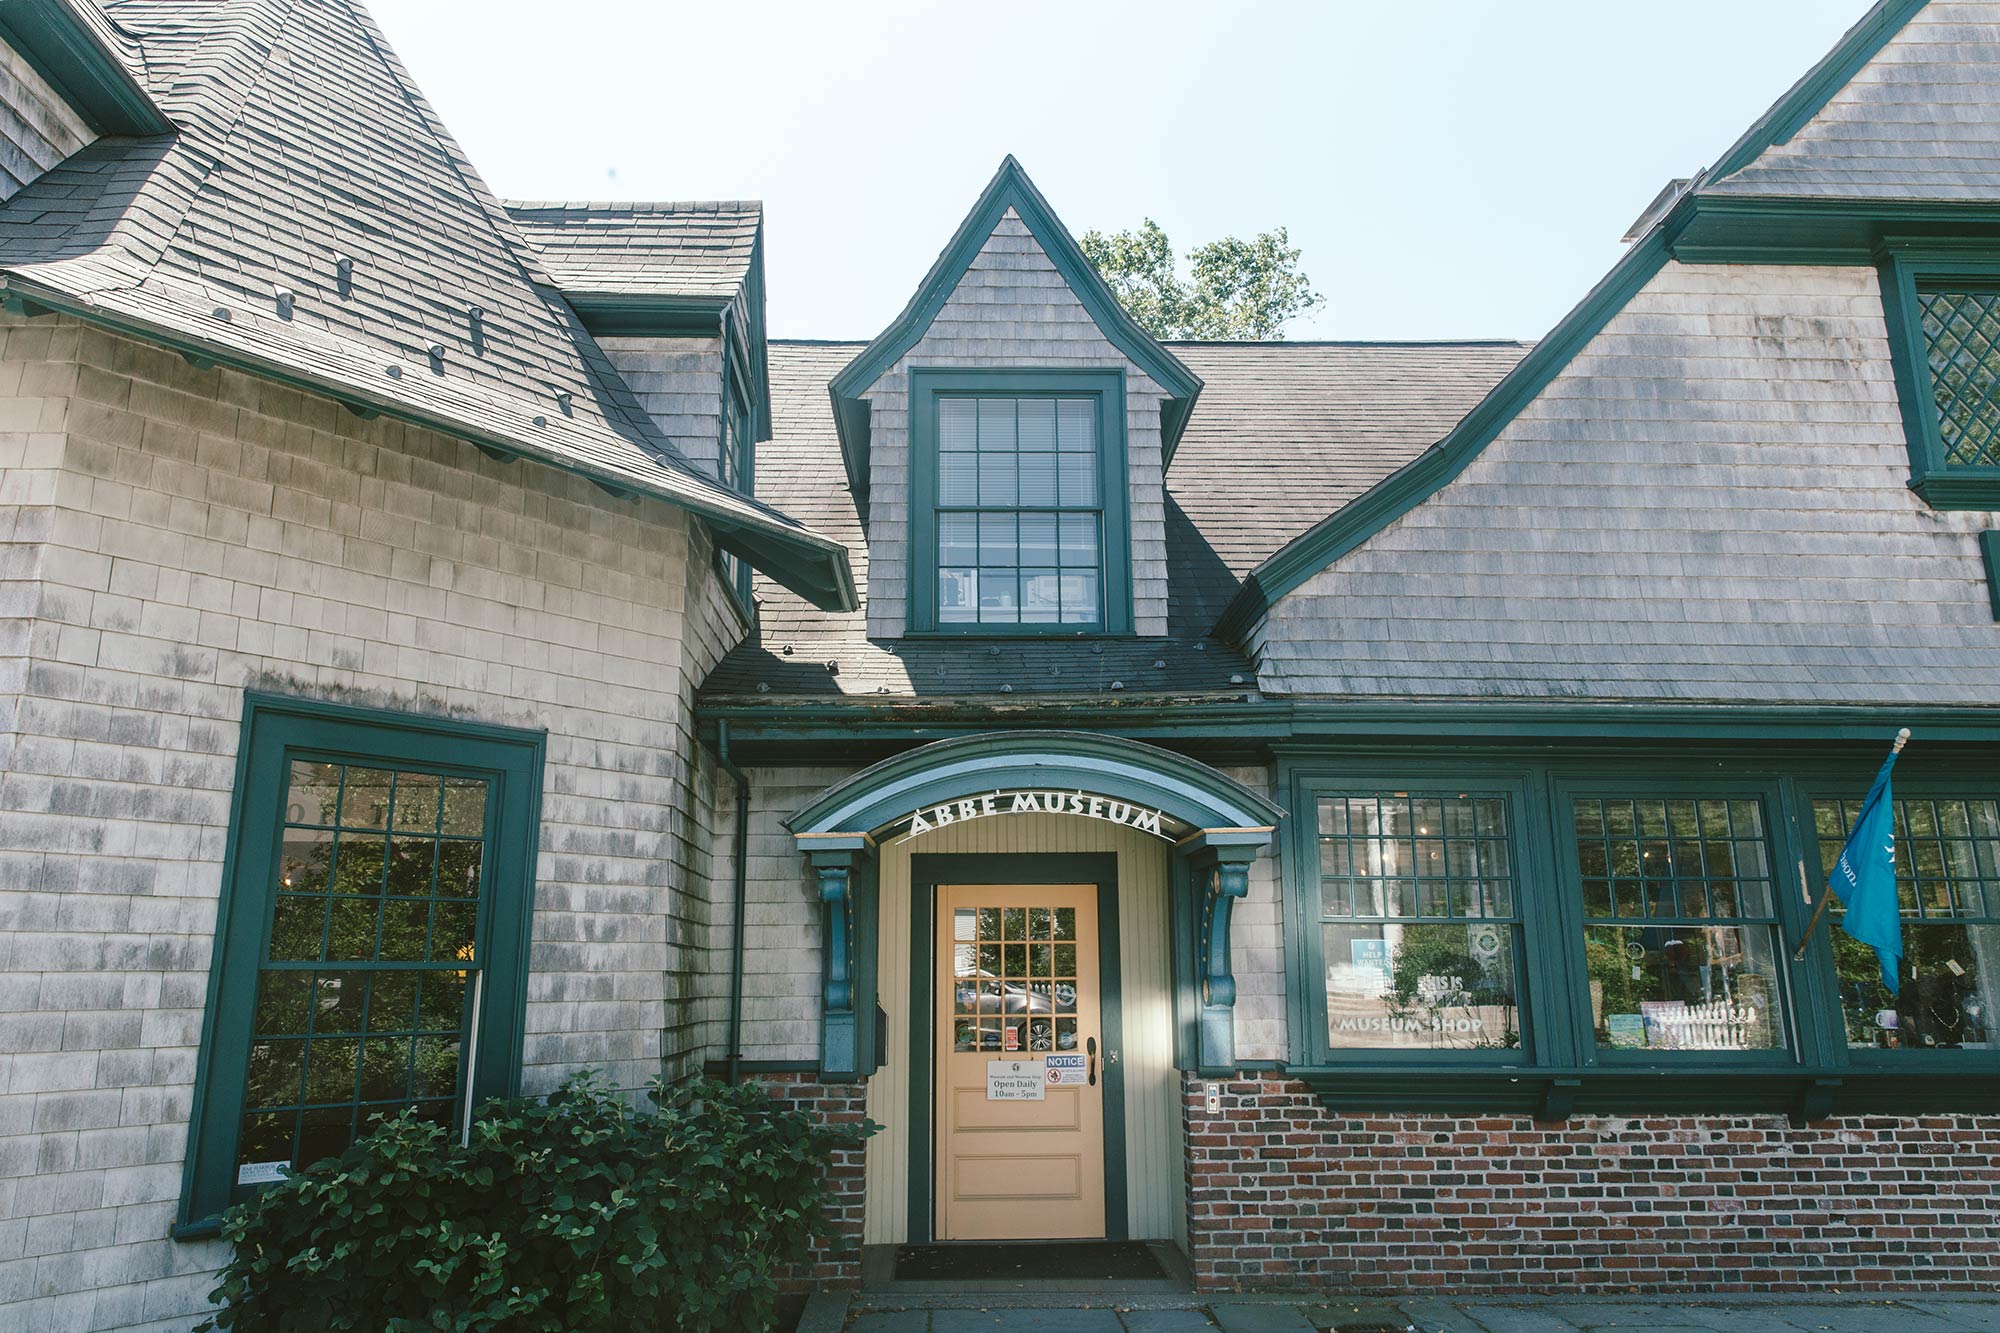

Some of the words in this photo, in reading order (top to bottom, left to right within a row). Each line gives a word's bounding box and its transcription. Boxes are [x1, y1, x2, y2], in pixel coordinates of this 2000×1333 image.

[909, 793, 998, 837] ABBE
[1010, 791, 1162, 836] MUSEUM
[1362, 951, 1383, 959] HELP
[1450, 975, 1464, 991] IS
[1338, 1017, 1423, 1033] MUSEUM
[1432, 1017, 1483, 1033] SHOP
[1048, 1057, 1084, 1066] NOTICE
[994, 1080, 1015, 1089] Open
[1016, 1080, 1038, 1089] Daily
[994, 1090, 1015, 1098] 10am
[1021, 1090, 1038, 1099] 5pm
